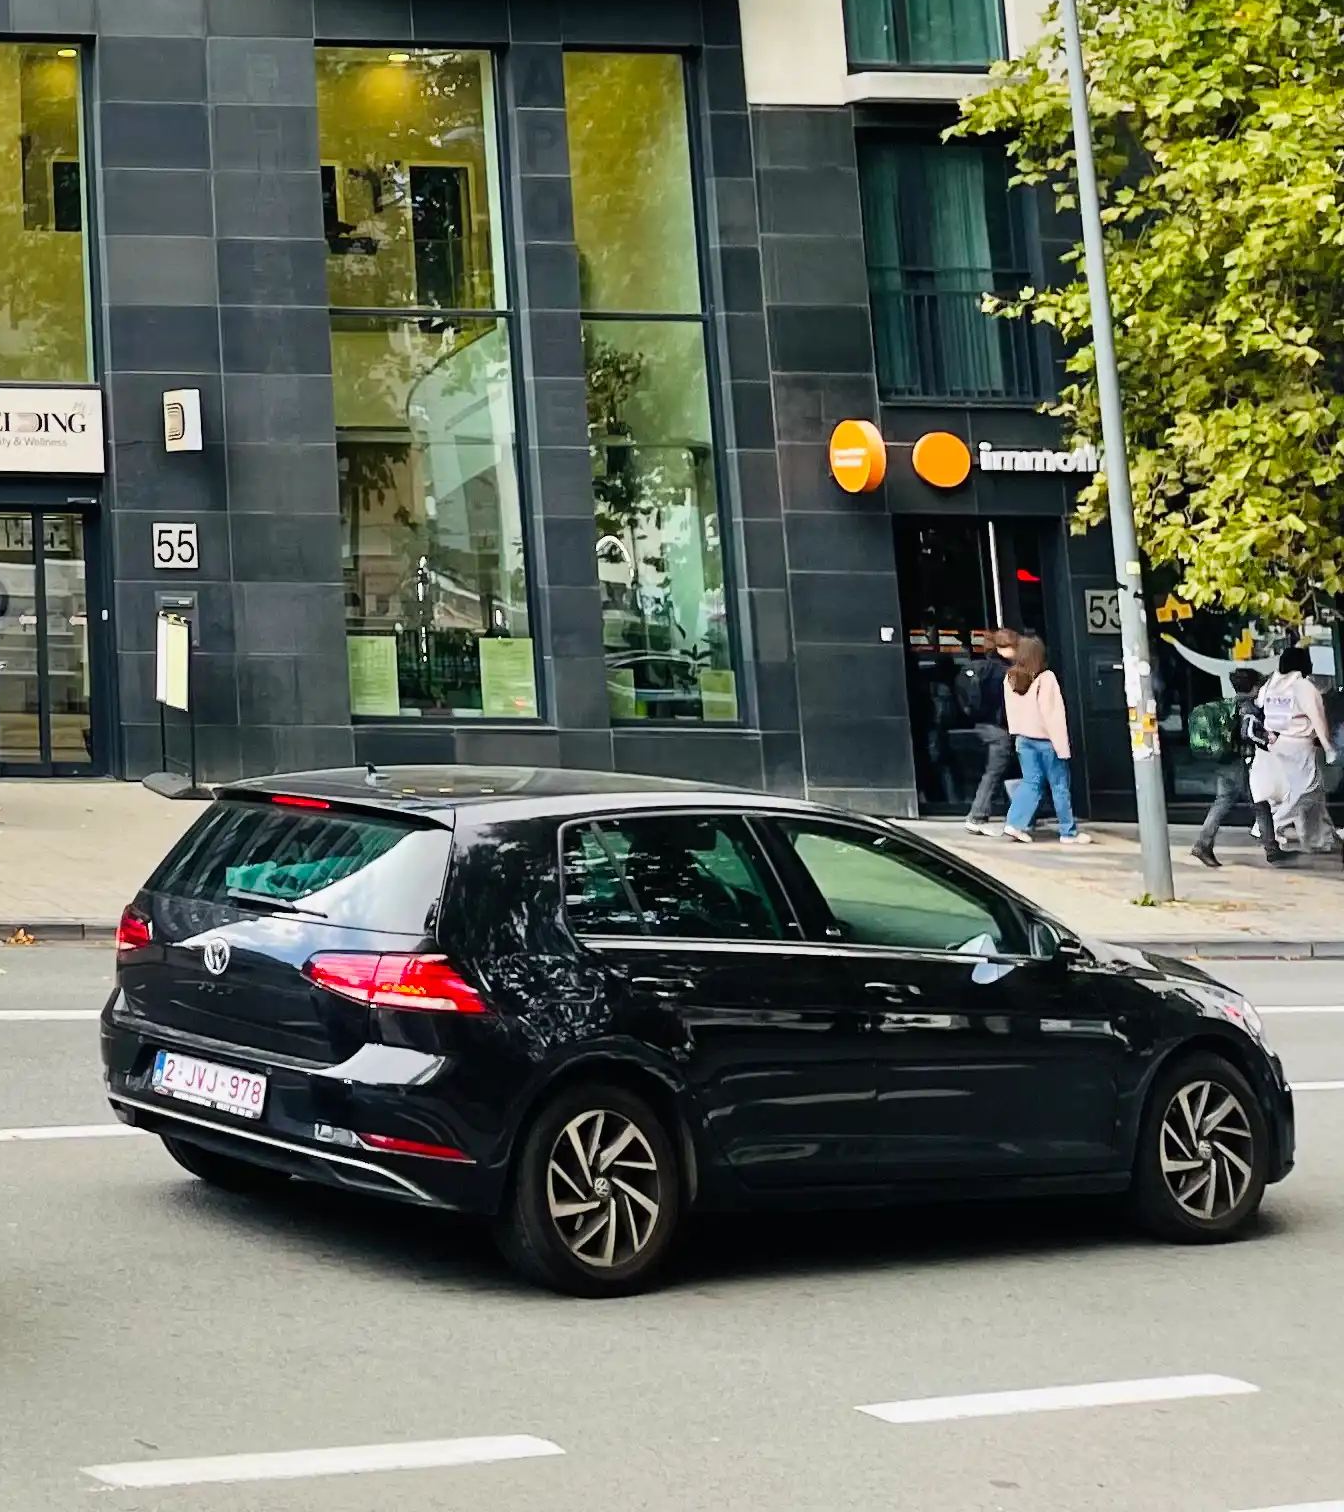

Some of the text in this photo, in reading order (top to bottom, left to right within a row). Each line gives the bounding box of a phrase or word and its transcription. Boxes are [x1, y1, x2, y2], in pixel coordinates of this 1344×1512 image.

[13, 436, 22, 446] &
[24, 437, 68, 447] Wellness
[157, 529, 195, 563] 55
